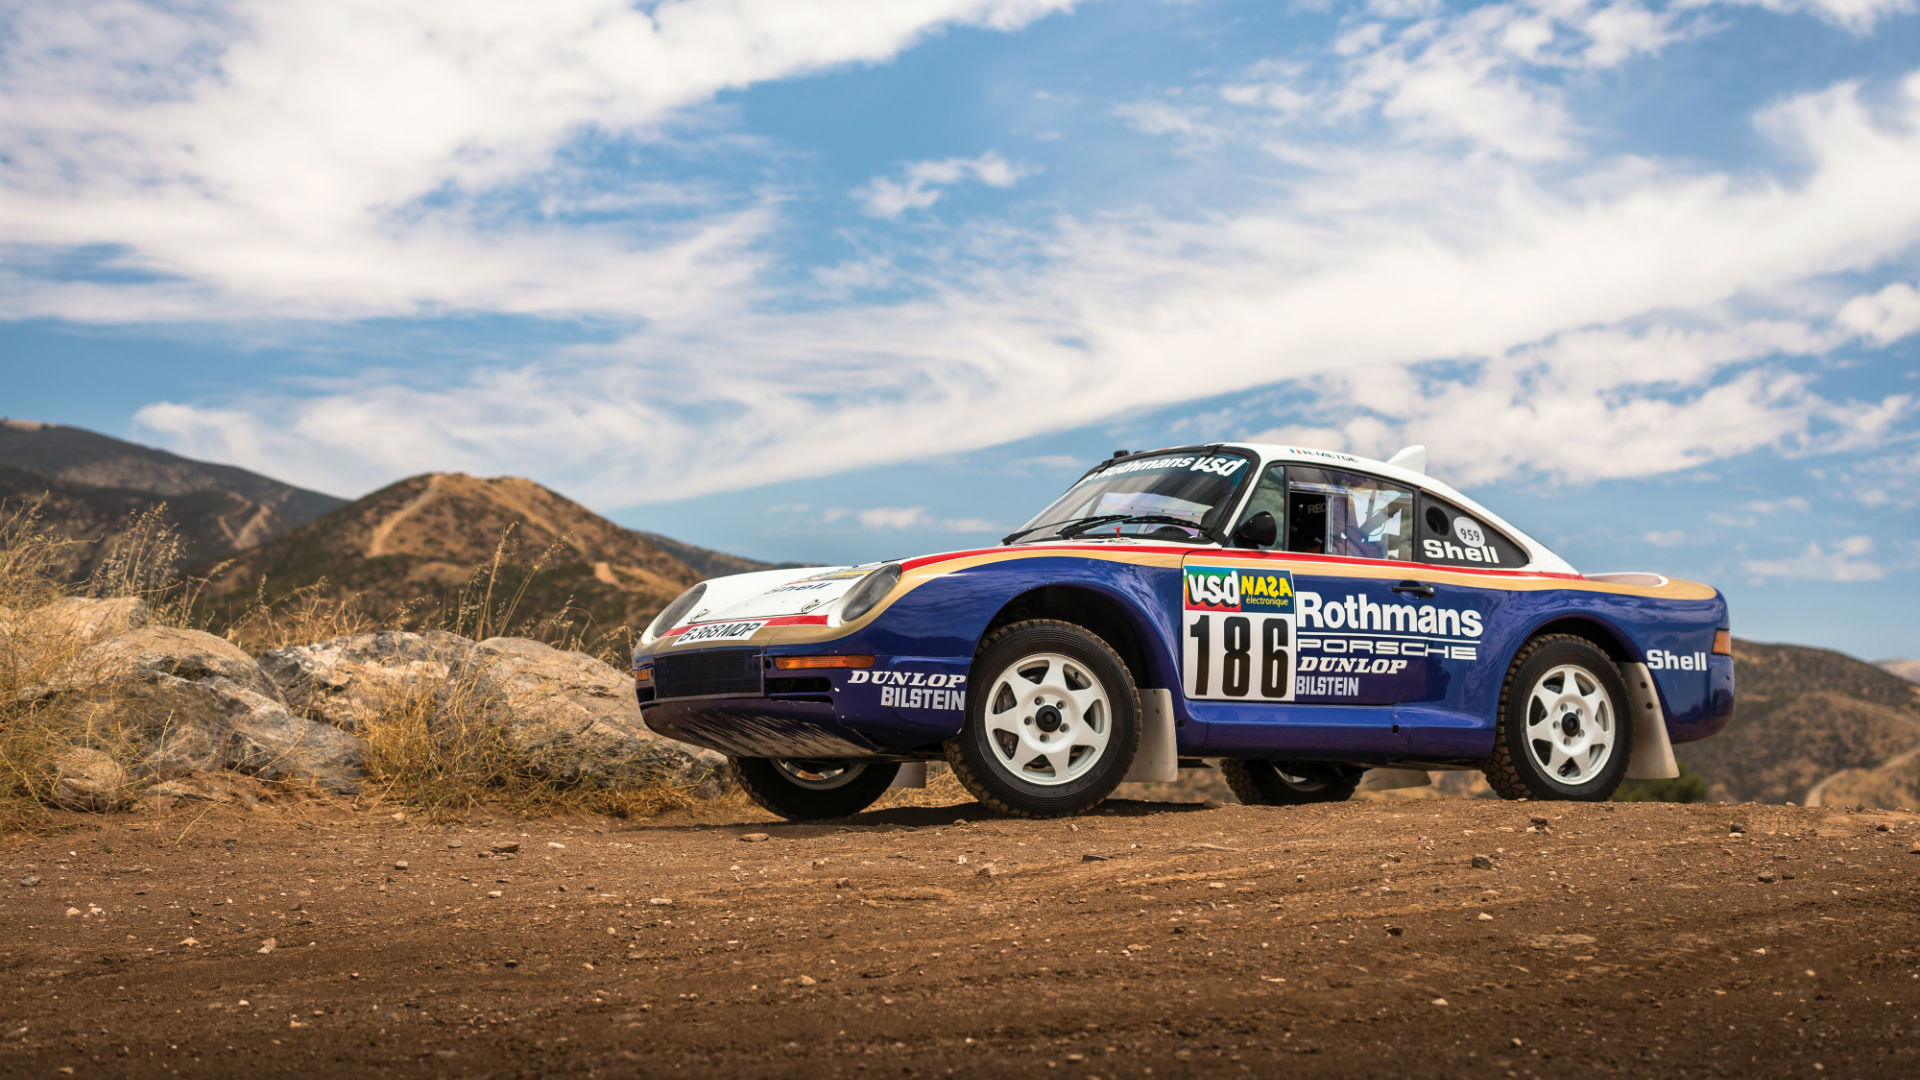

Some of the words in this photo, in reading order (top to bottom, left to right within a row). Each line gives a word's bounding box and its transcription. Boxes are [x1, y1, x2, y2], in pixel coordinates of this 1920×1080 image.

[1460, 527, 1480, 542] 959
[1423, 539, 1500, 564] Shell
[1188, 570, 1240, 605] vsd
[1245, 594, 1289, 608] électronique
[1296, 591, 1483, 637] Rothmans
[1189, 614, 1289, 698] 186
[1297, 638, 1478, 660] PORSCHE
[1298, 656, 1408, 675] DUNLOP
[1646, 649, 1708, 672] Shell
[848, 670, 967, 688] DUNLOP
[1296, 675, 1360, 697] BILSTEIN
[880, 685, 966, 712] BILSTEIN
